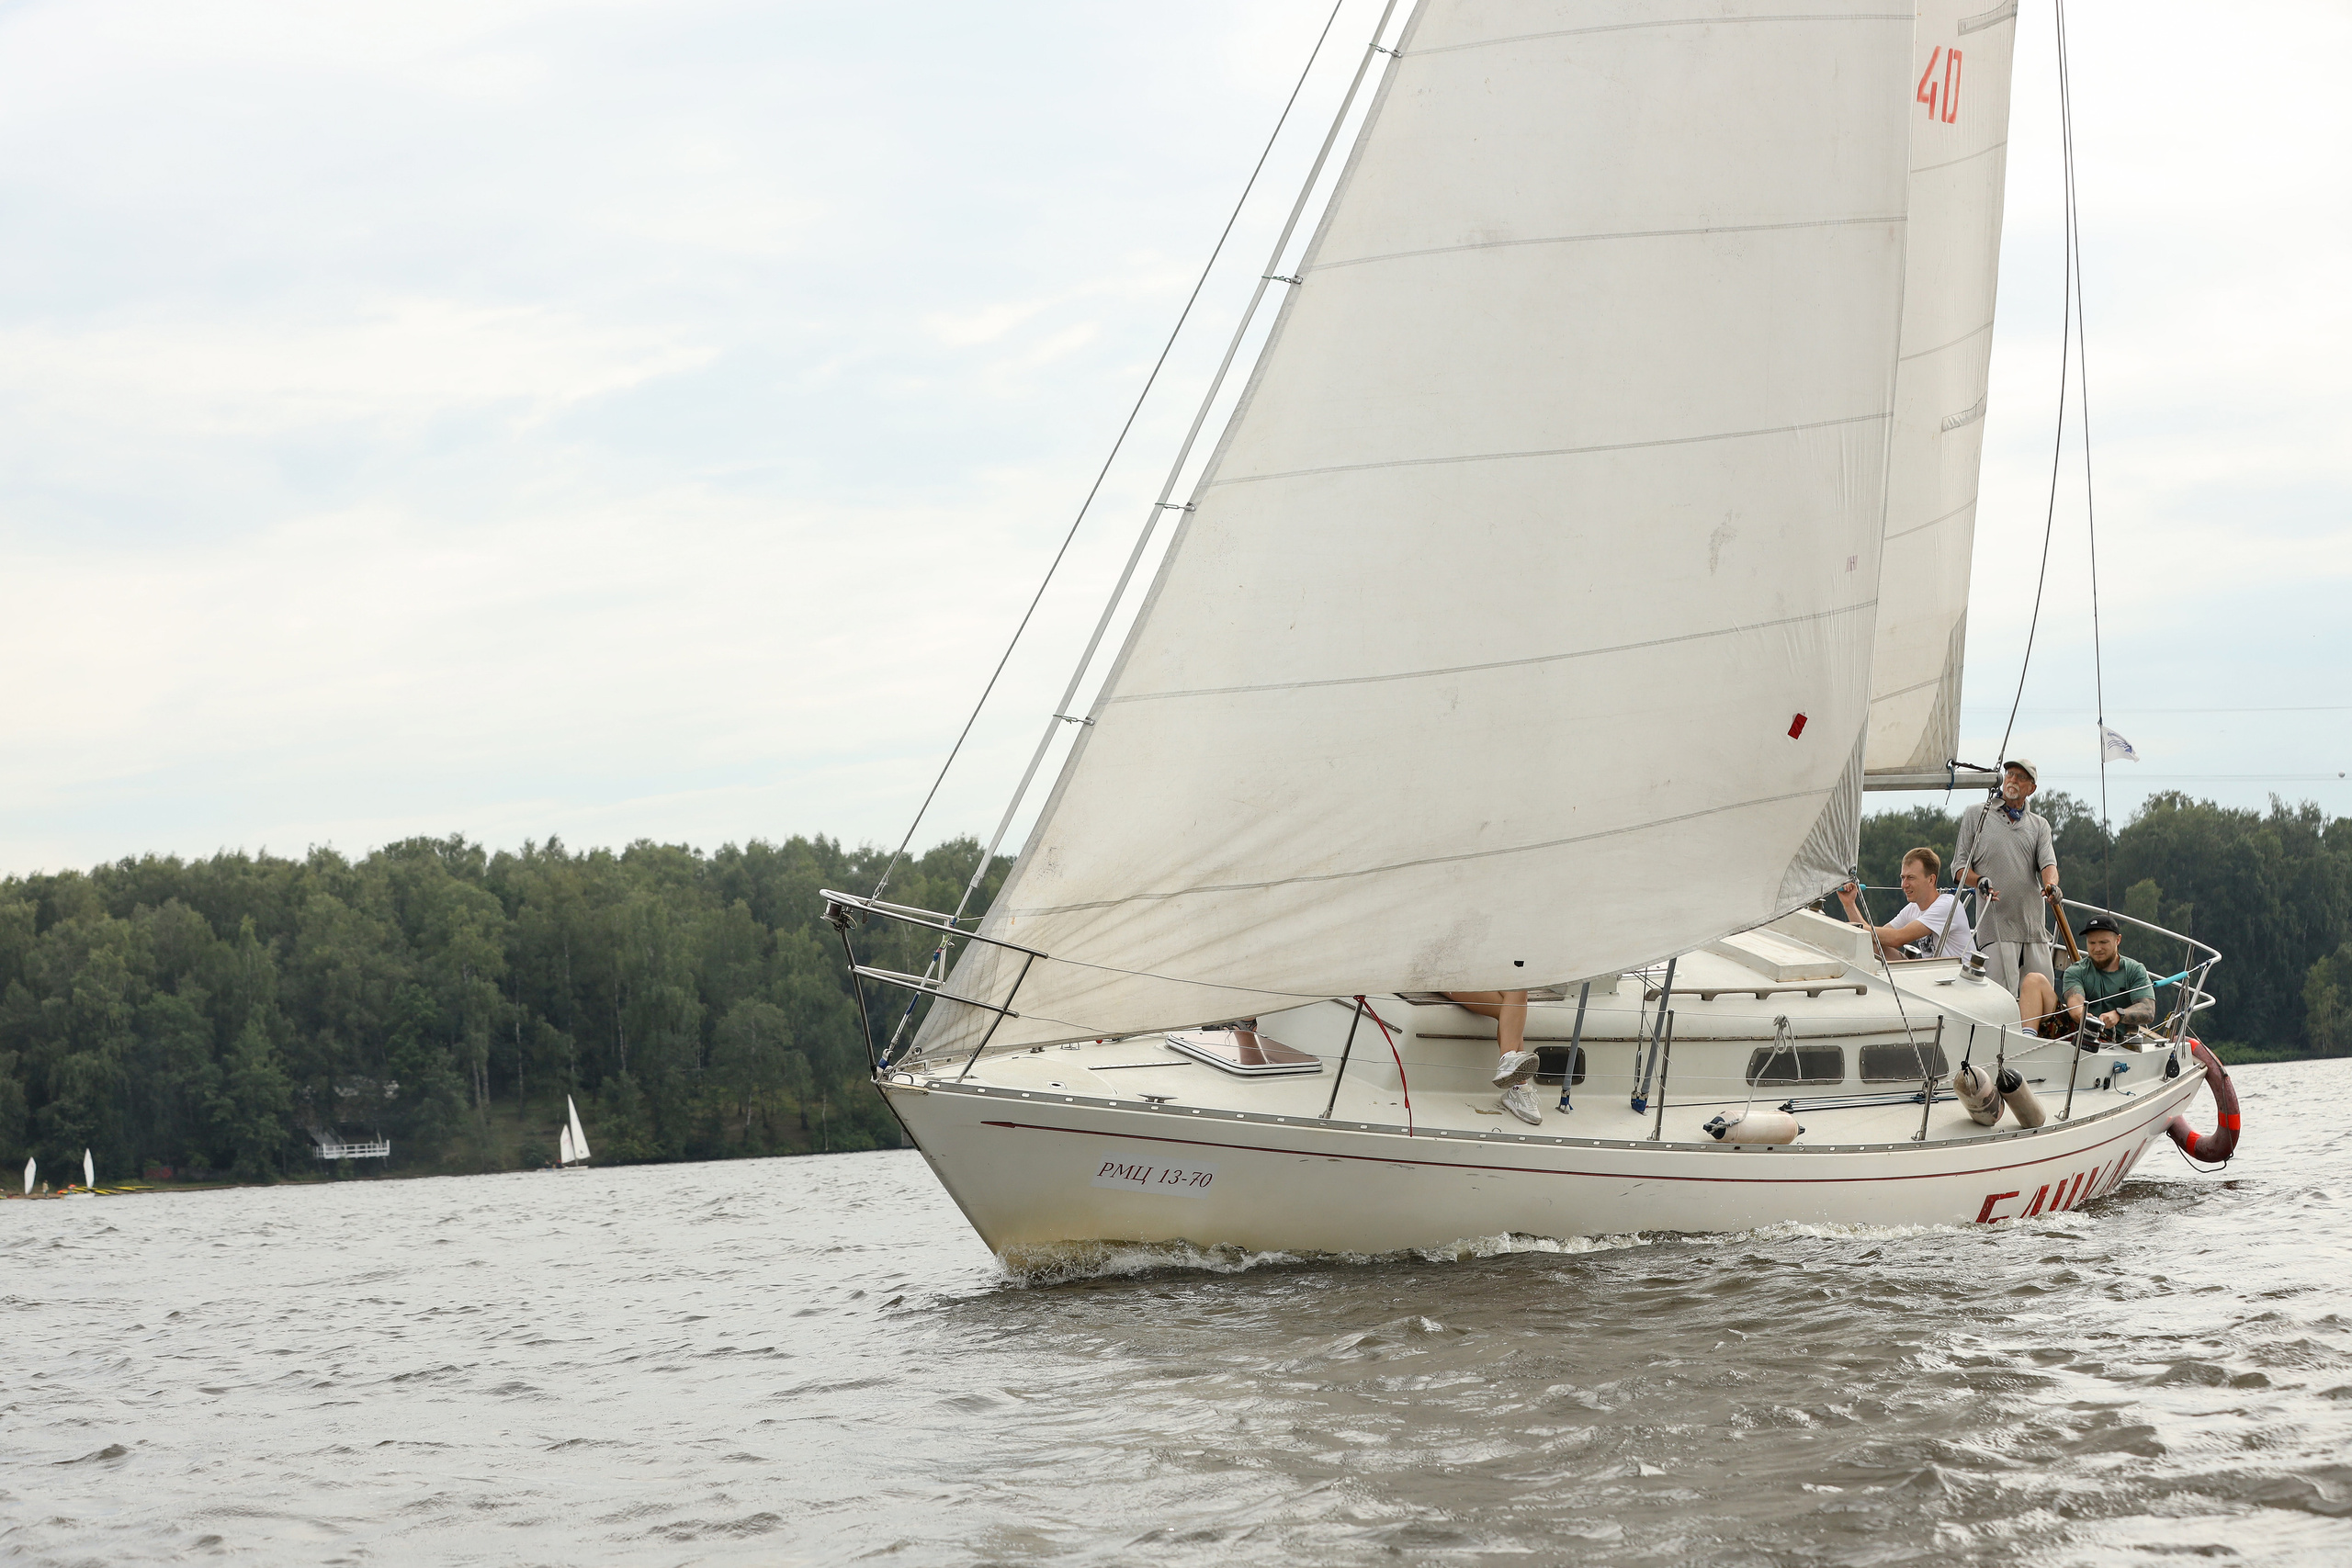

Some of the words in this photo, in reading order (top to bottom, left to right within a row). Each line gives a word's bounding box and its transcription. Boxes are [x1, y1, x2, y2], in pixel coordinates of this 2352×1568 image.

[1916, 45, 1963, 125] 40
[1096, 1161, 1154, 1186] РМЦ
[1157, 1168, 1214, 1189] 13-70
